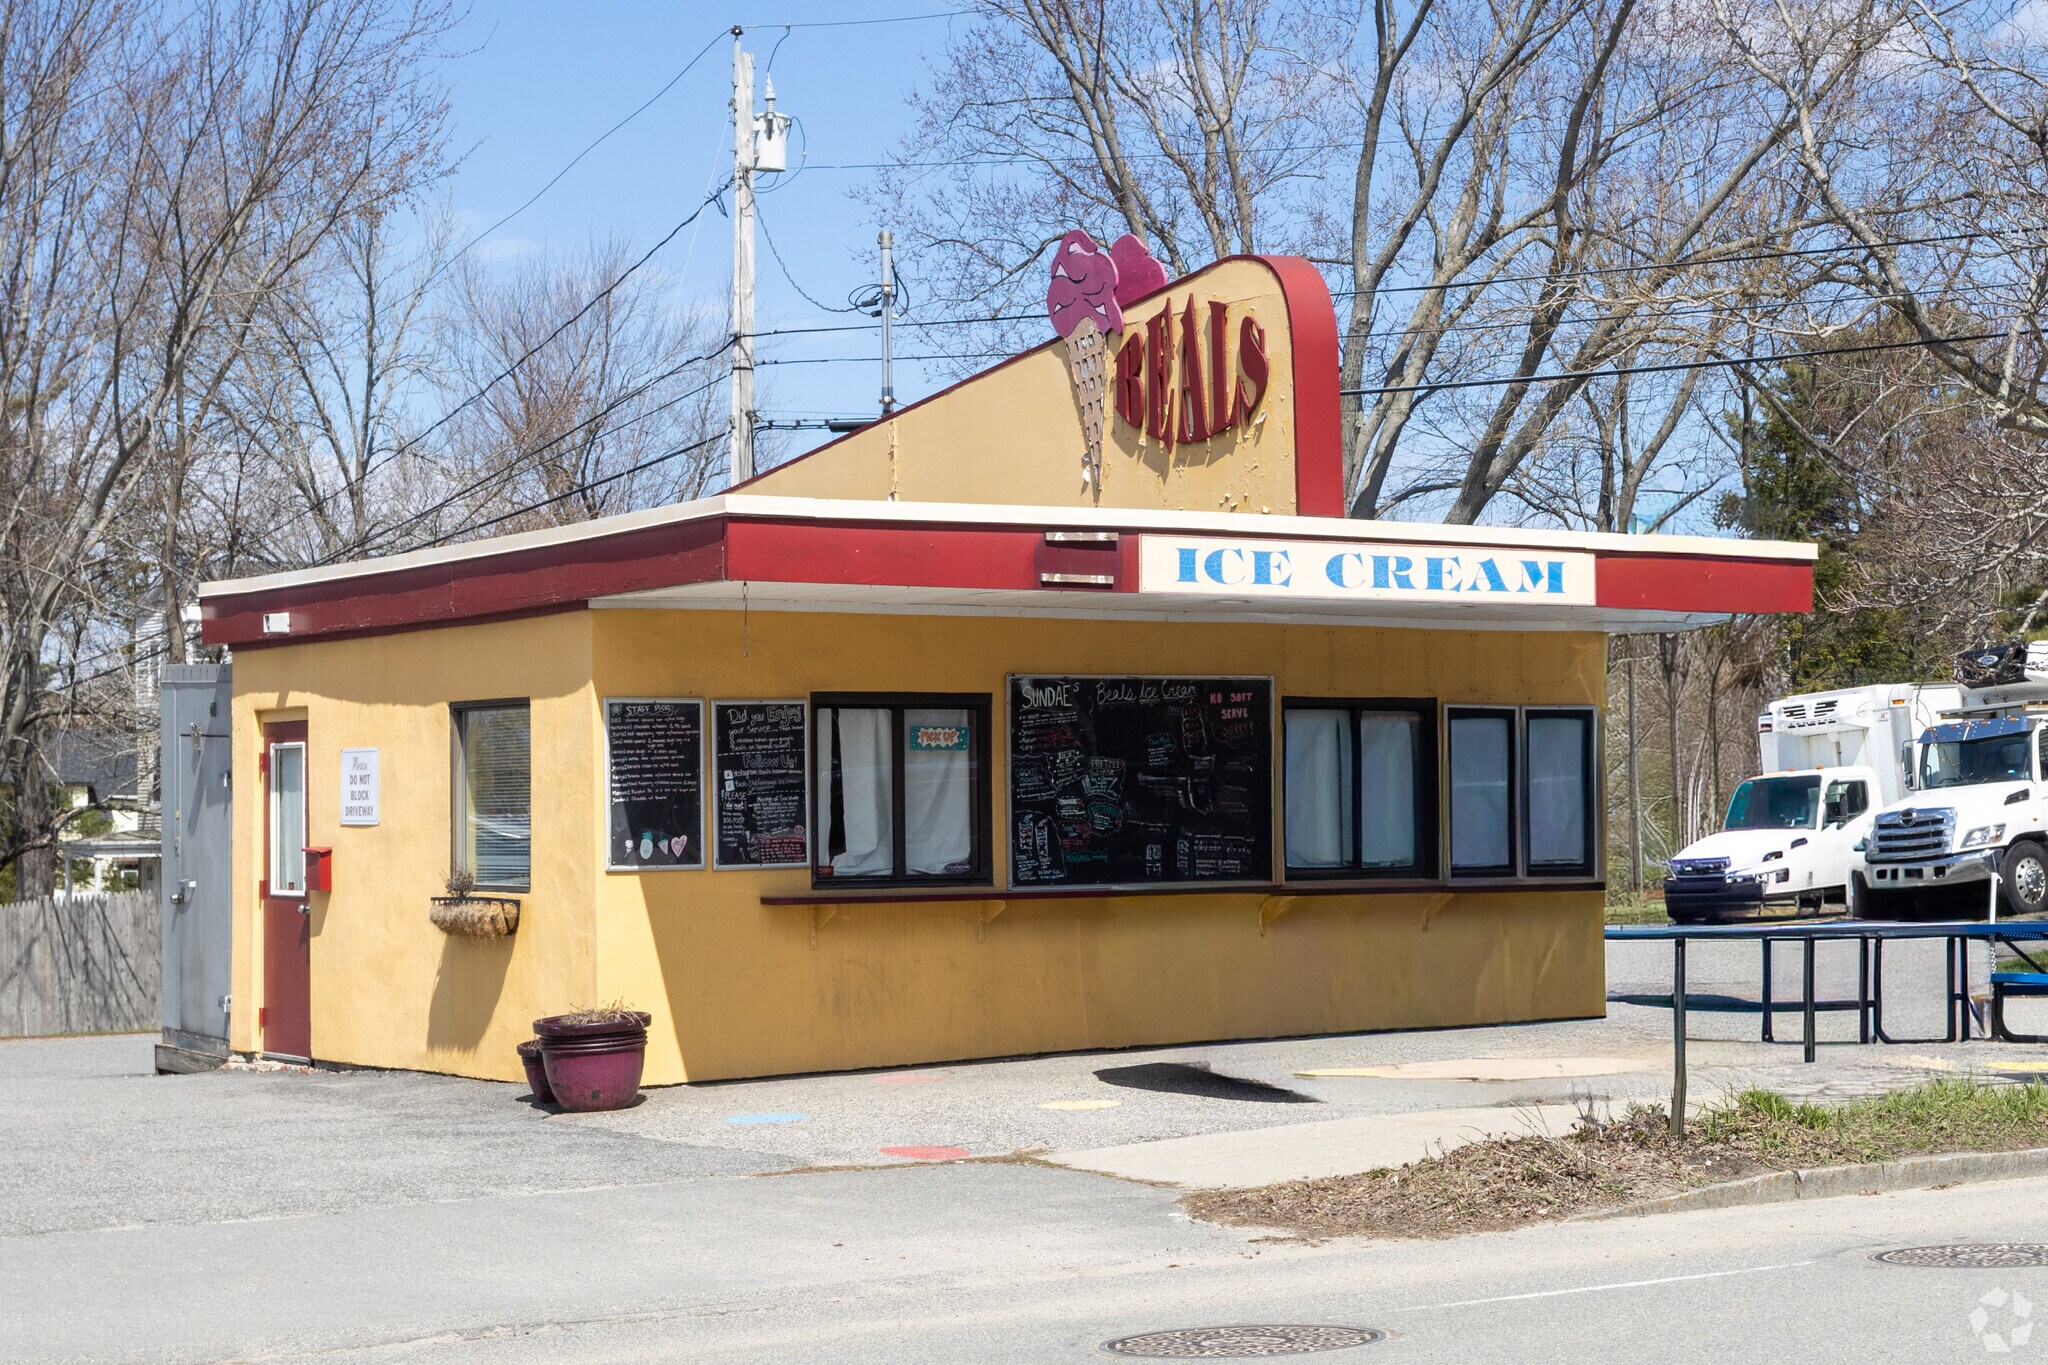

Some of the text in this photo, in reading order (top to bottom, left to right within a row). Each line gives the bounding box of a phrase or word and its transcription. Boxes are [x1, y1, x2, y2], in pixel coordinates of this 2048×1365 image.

[1114, 292, 1270, 453] BEALS
[1175, 546, 1568, 595] ICE CREAM
[1095, 679, 1198, 703] Beals Ice Cream
[1210, 691, 1253, 704] NO SOFT
[625, 705, 650, 717] STAFF
[727, 705, 801, 727] Did you Enjoy
[1221, 707, 1248, 720] SERVE
[920, 730, 958, 743] PICK UP
[353, 757, 367, 771] Please
[743, 754, 798, 769] Follow Us!
[349, 774, 371, 785] DO NOT
[350, 790, 369, 801] BLOCK
[725, 791, 747, 800] PLEASE
[345, 805, 374, 817] DRIVEWAY
